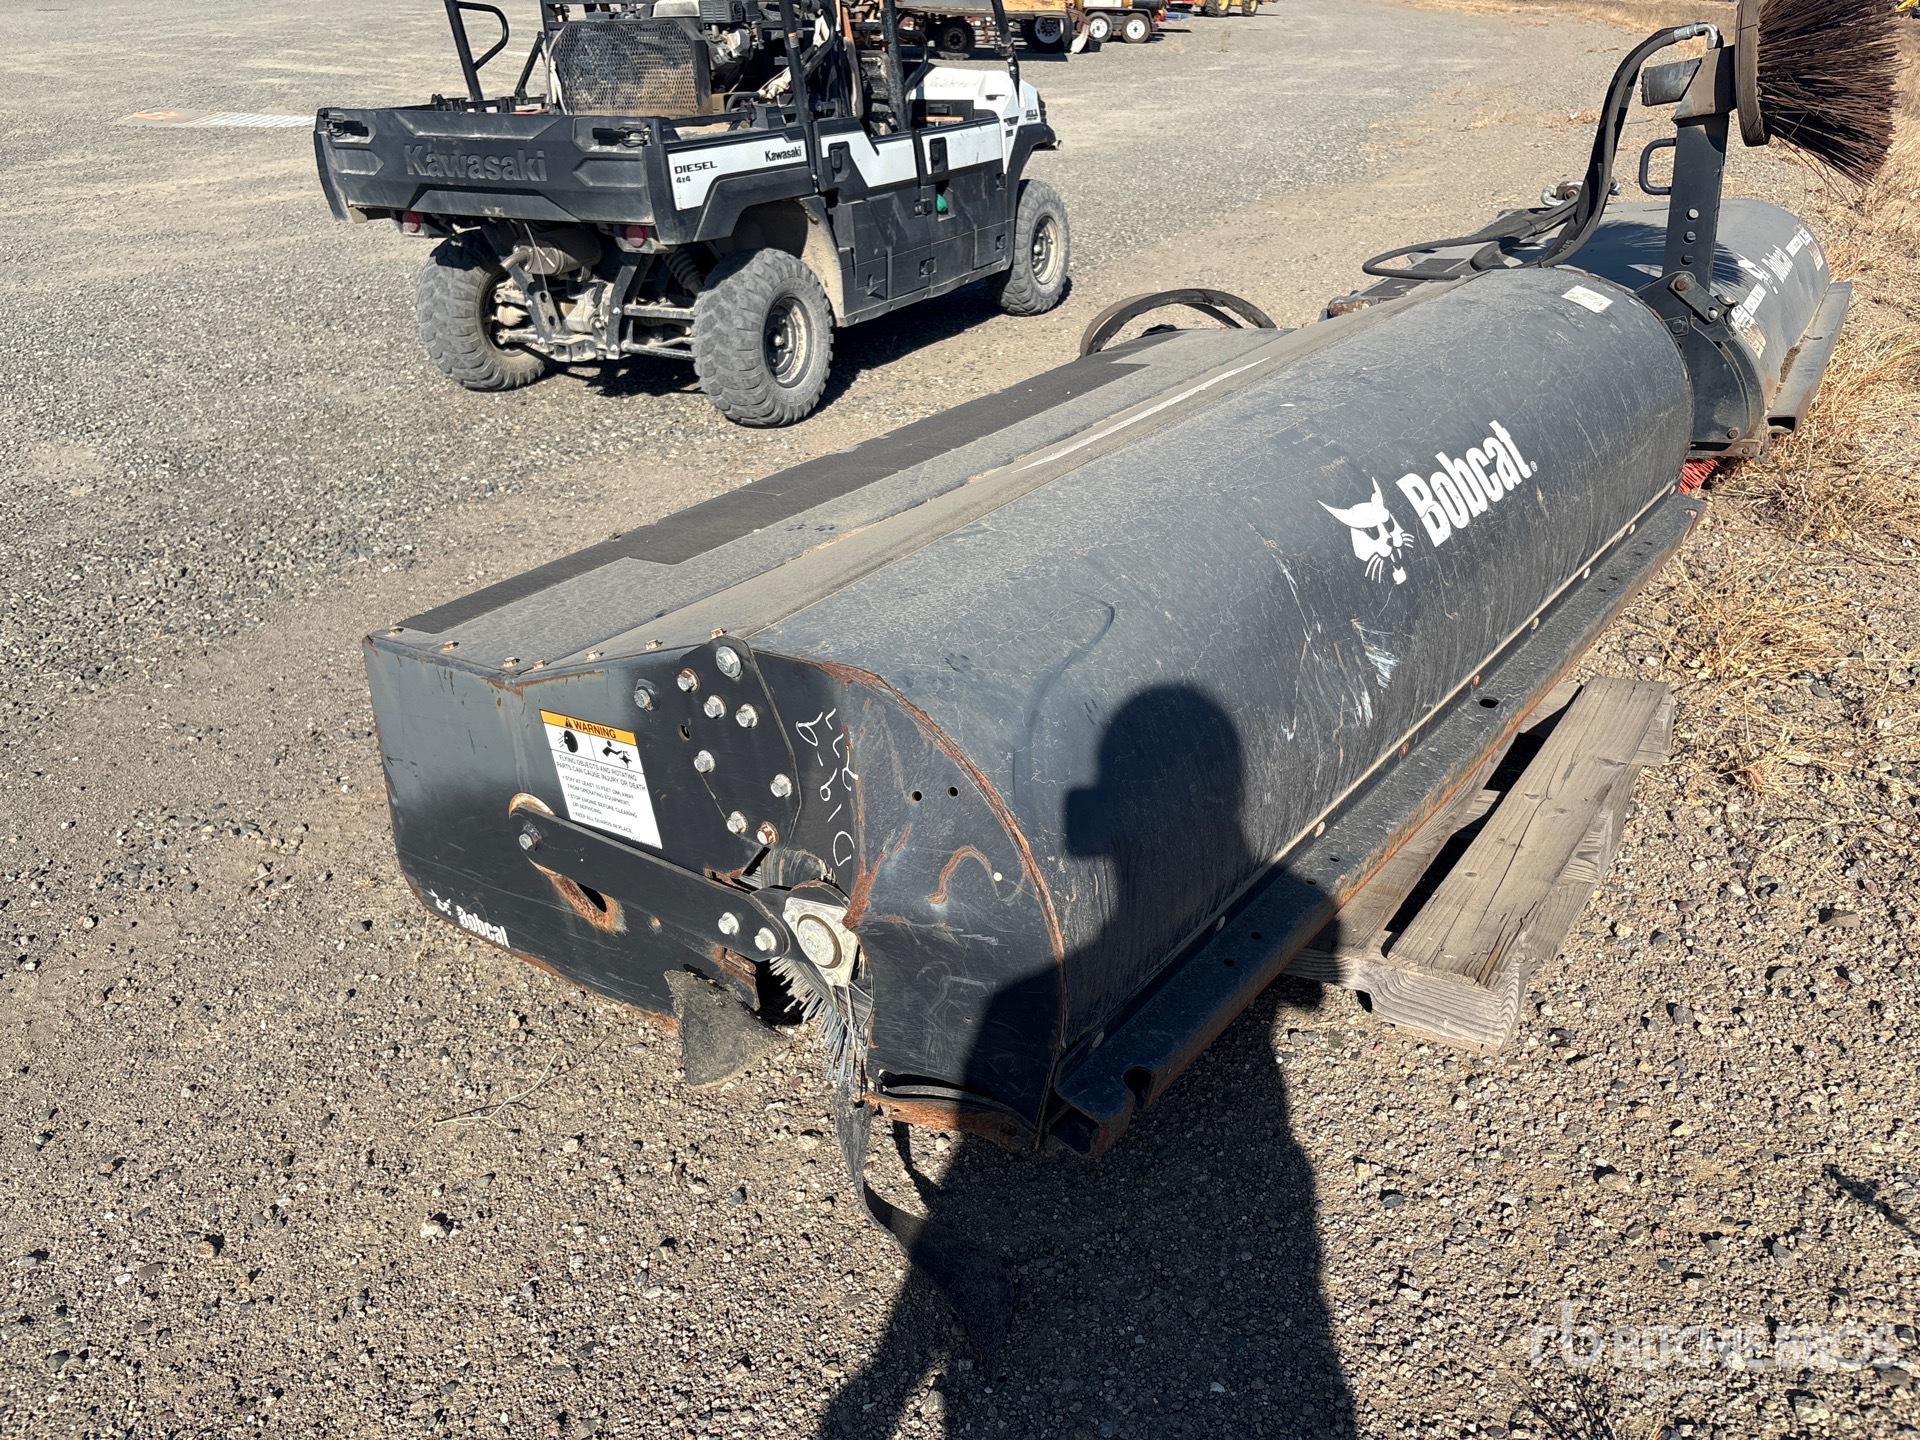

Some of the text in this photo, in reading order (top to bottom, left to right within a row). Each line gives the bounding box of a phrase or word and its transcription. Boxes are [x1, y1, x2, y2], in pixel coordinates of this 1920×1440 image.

[404, 144, 548, 182] Kawasaki
[765, 146, 802, 162] Kawasaki
[674, 161, 718, 174] DIESEL
[676, 175, 691, 184] 4x4
[572, 719, 617, 739] WARNING
[555, 760, 572, 771] PARTS
[571, 765, 583, 774] CAN
[583, 768, 601, 779] CAUSE
[600, 773, 619, 784] INJURY
[619, 778, 628, 787] OR
[558, 753, 637, 782] FLYING OBJECTS AND ROTATING
[456, 904, 511, 949] Bobcat
